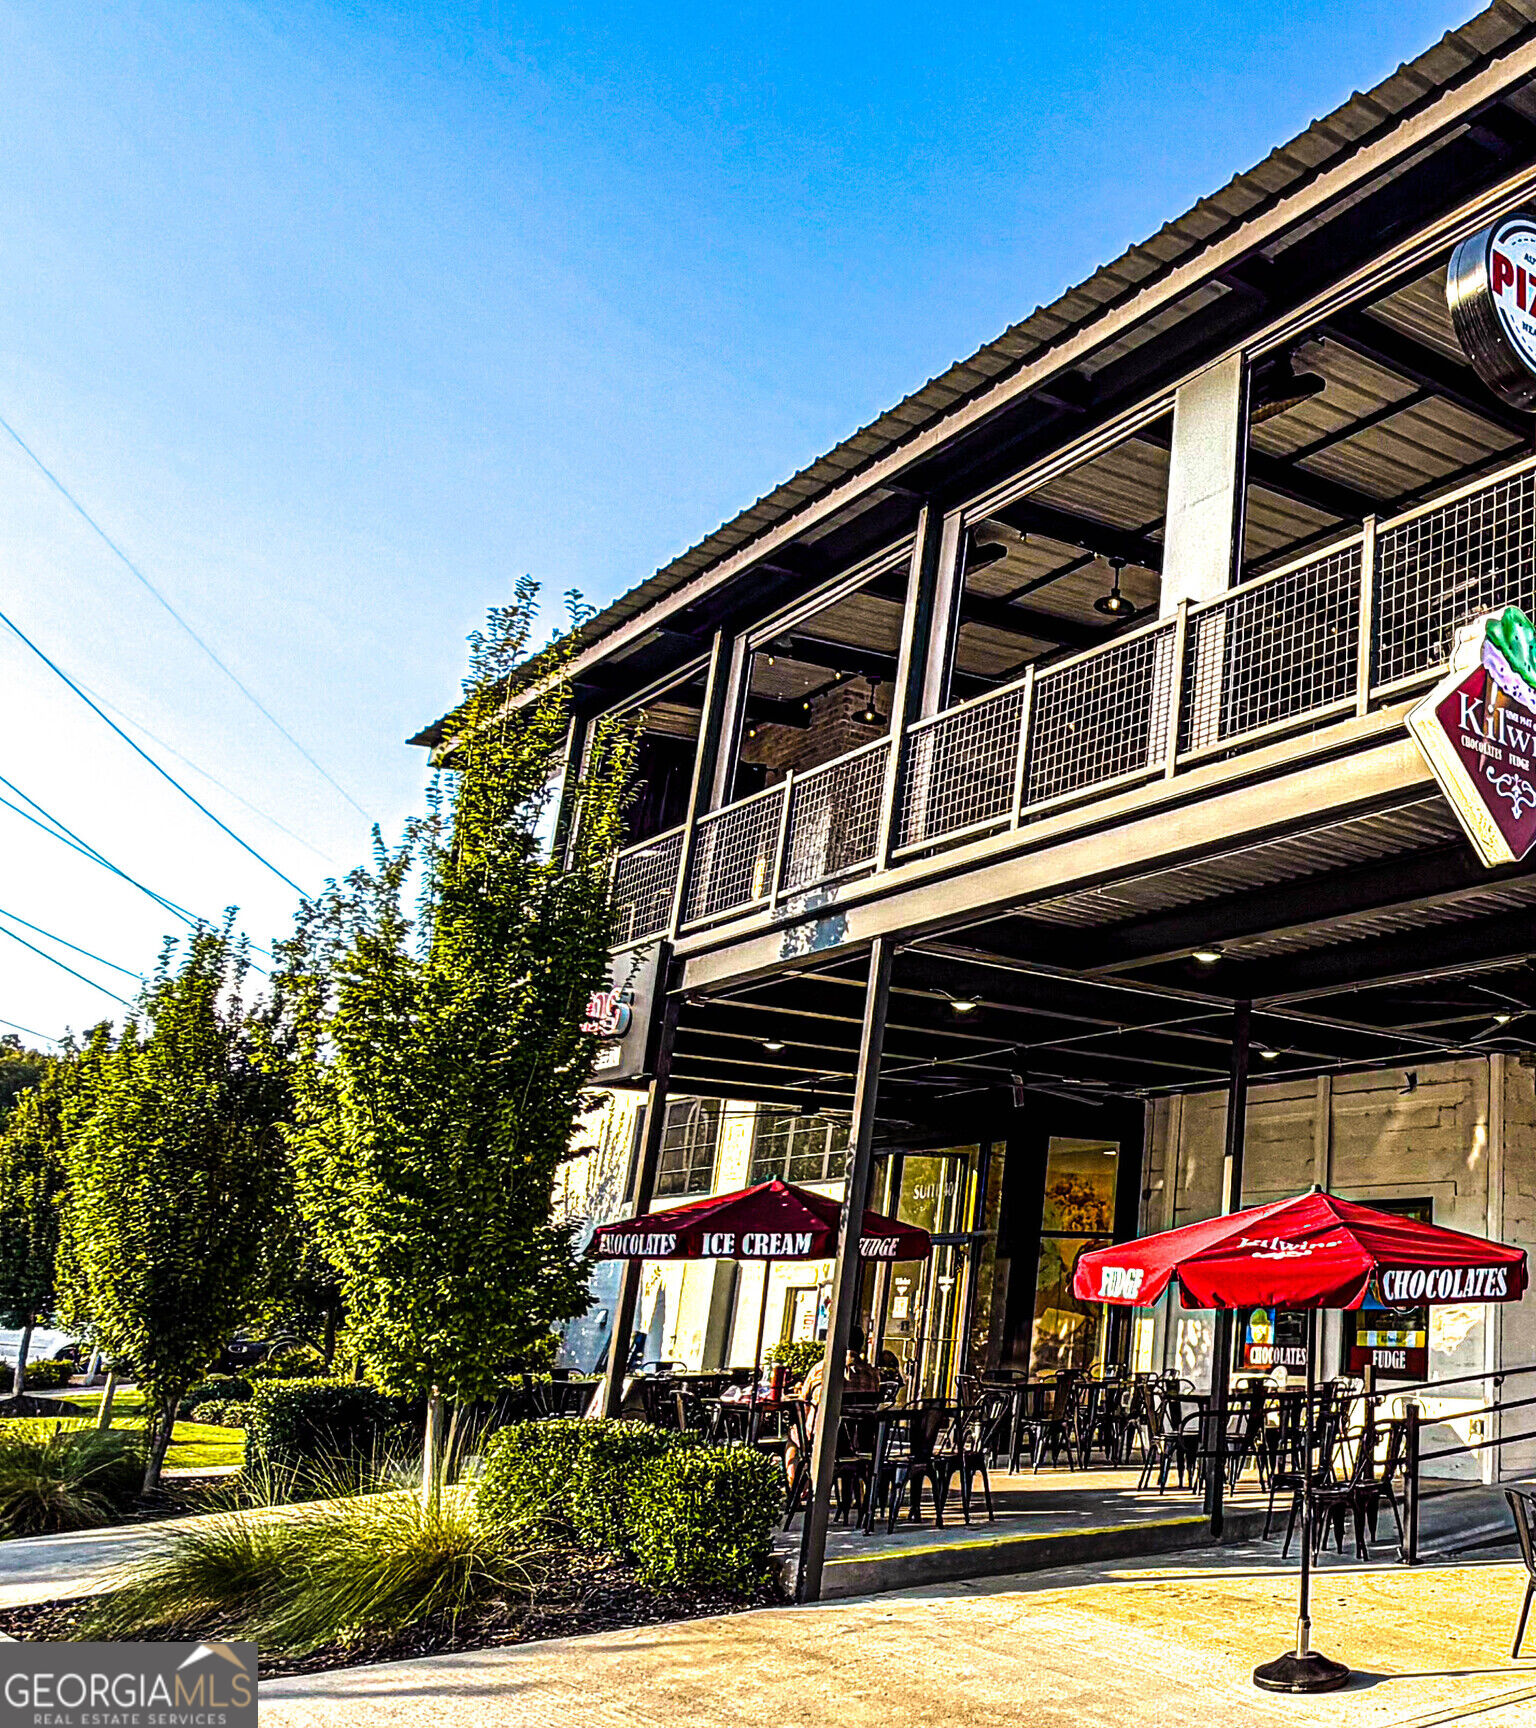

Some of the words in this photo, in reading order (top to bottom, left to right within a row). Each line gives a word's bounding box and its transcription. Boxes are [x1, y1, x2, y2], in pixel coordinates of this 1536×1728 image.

[1461, 734, 1503, 761] CHOCOLATES
[702, 1232, 735, 1256] ICE
[742, 1231, 813, 1256] CREAM
[1098, 1266, 1144, 1299] FUDGE
[1381, 1266, 1508, 1300] CHOCOLATES
[1250, 1347, 1307, 1366] CHOCOLATES
[1372, 1350, 1406, 1369] FUDGE
